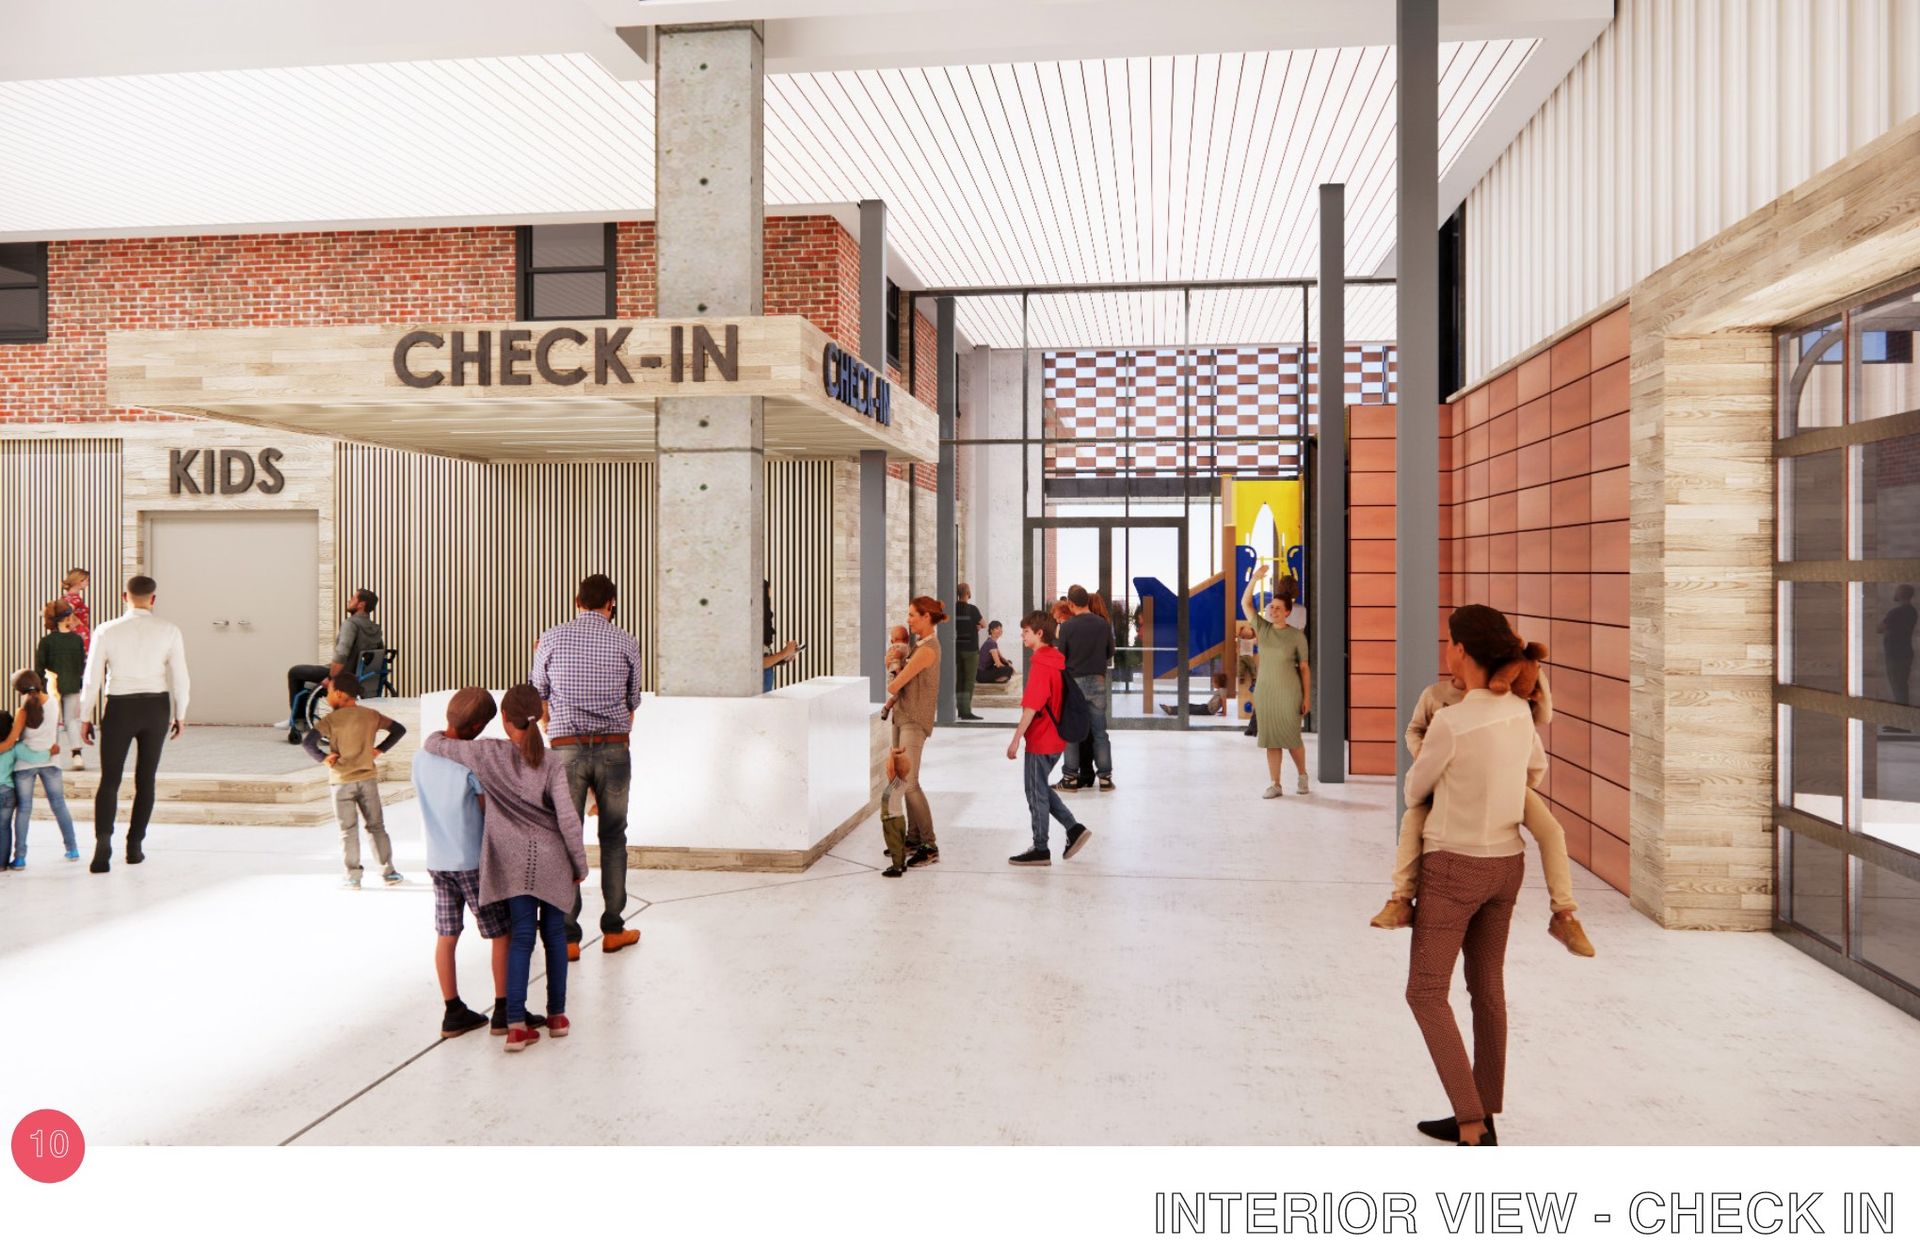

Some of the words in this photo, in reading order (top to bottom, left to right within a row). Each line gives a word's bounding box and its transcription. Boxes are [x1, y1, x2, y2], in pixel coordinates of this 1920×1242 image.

[393, 324, 738, 389] CHECK-IN
[823, 342, 891, 427] CHECK-IN
[169, 447, 285, 495] KIDS
